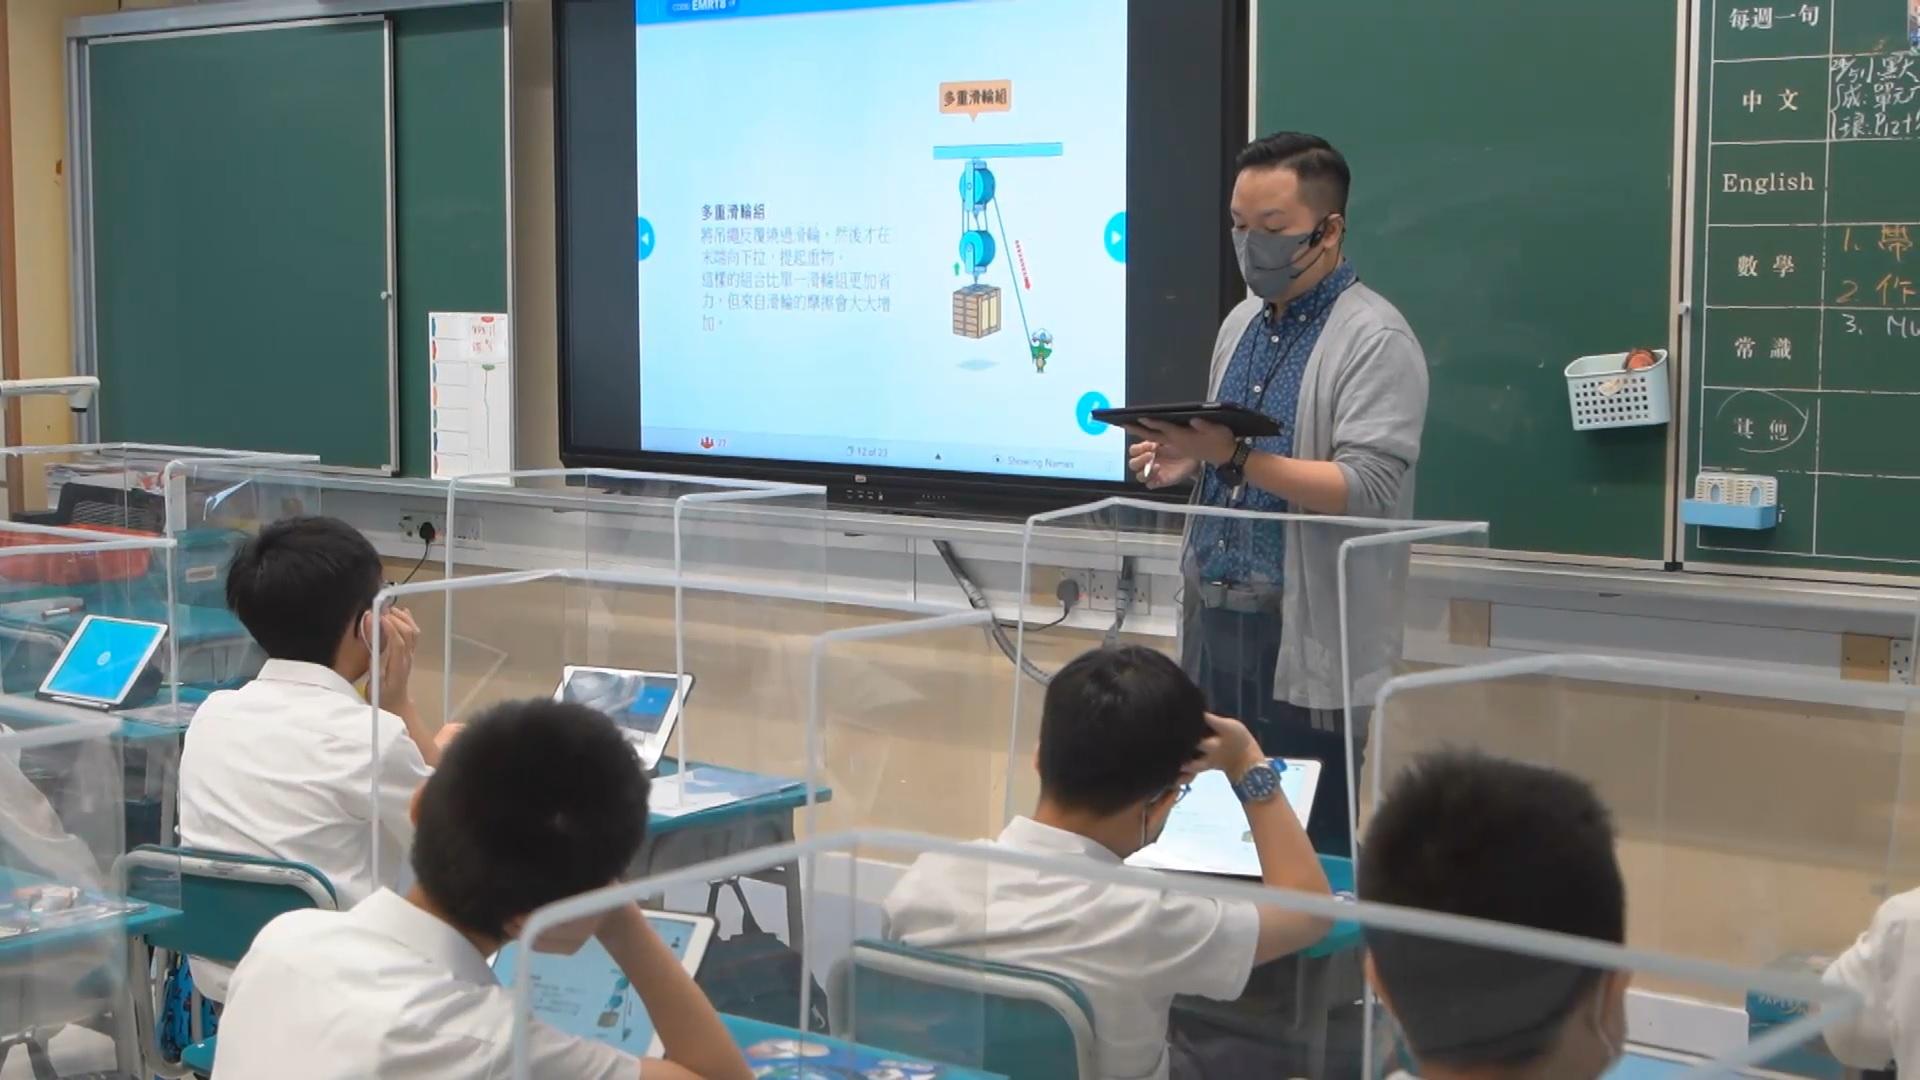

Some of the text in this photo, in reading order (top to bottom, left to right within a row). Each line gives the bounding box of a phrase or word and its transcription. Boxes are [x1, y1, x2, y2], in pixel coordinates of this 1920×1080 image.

[1729, 4, 1820, 31] 每週一句
[943, 88, 1007, 107] 多重滑輪組
[1742, 88, 1800, 112] 中文
[1722, 172, 1815, 195] English
[702, 203, 765, 221] 多重滑輪組
[1737, 254, 1795, 278] 數學
[1734, 336, 1792, 360] 常識
[1008, 455, 1075, 470] Showing Names
